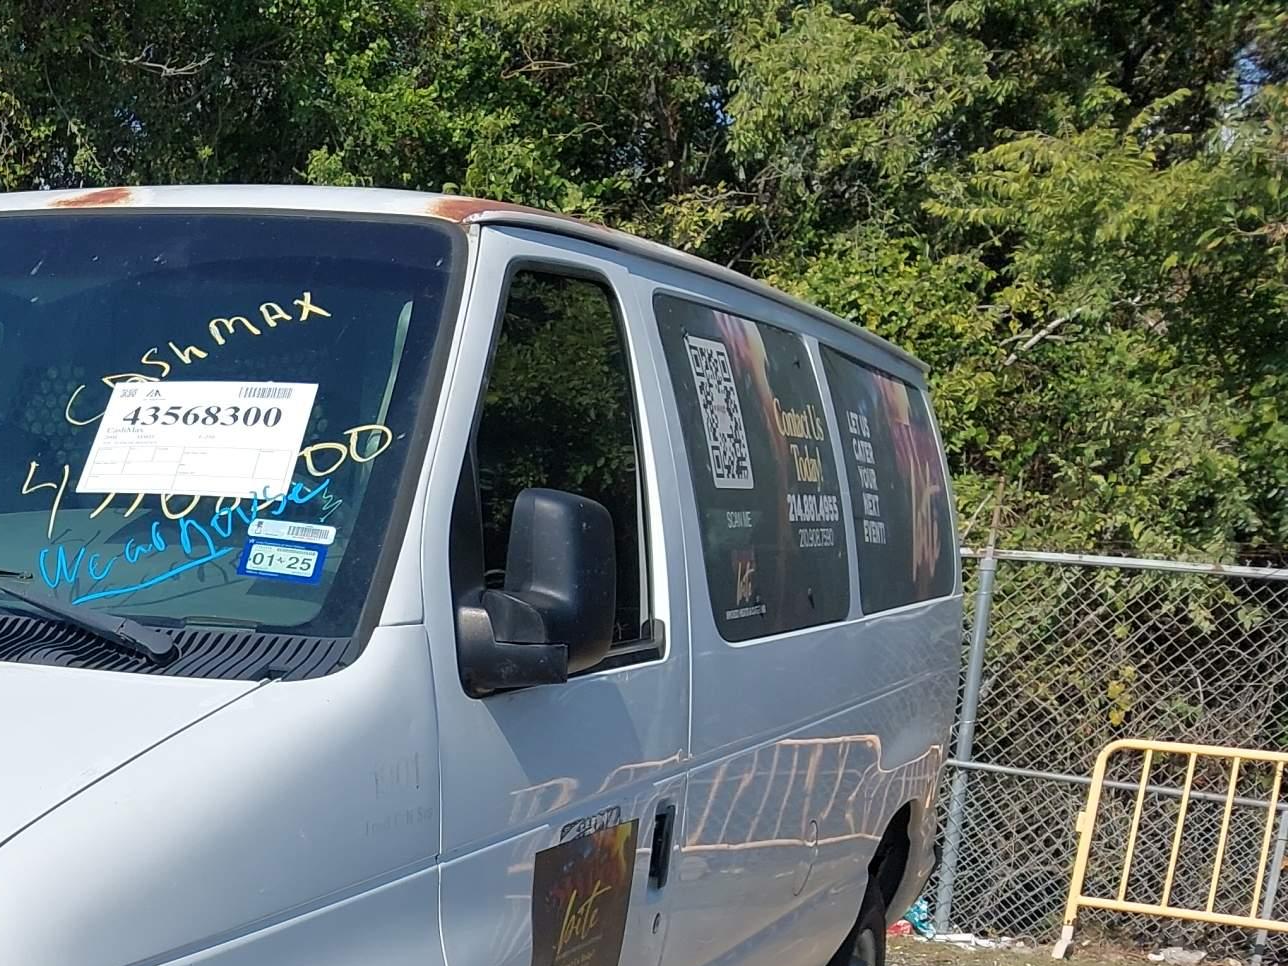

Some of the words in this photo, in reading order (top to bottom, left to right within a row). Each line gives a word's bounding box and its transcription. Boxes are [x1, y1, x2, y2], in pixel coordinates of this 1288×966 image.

[123, 405, 282, 428] 43568300
[773, 398, 813, 439] Contact
[807, 404, 825, 442] Us
[790, 444, 824, 492] Today!
[252, 552, 274, 567] 01
[286, 556, 313, 571] 25
